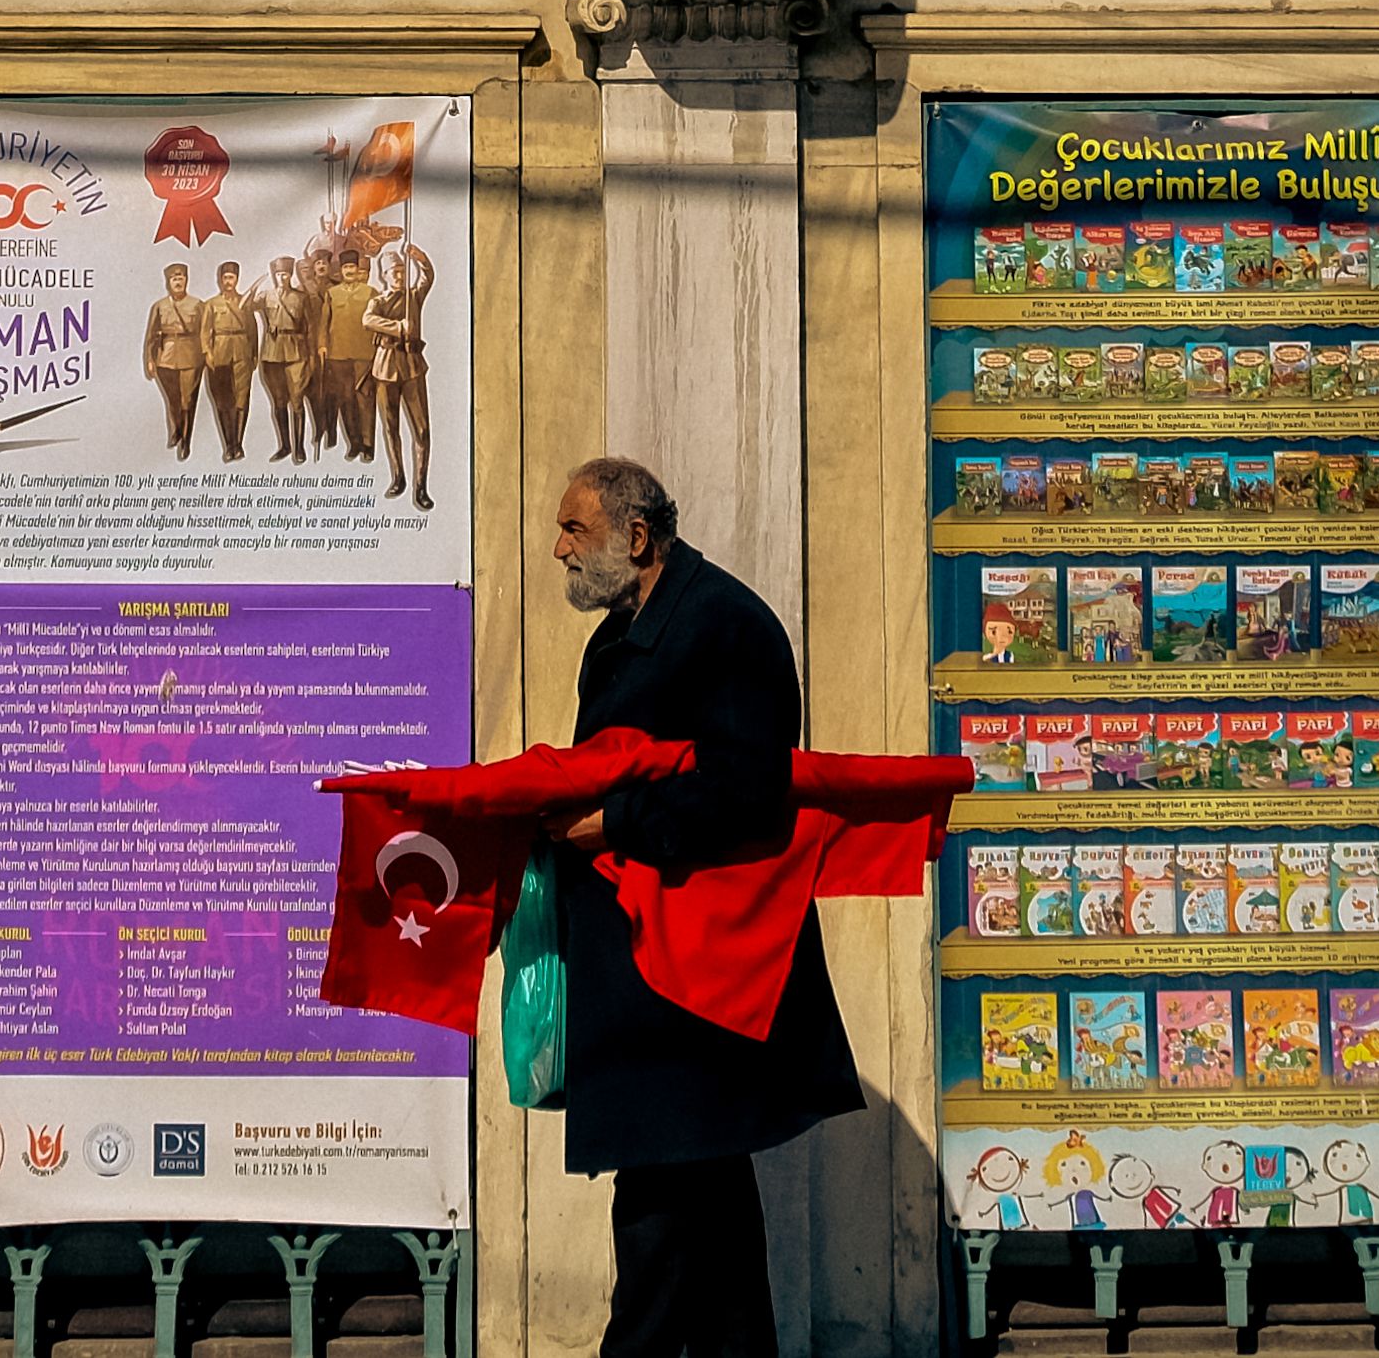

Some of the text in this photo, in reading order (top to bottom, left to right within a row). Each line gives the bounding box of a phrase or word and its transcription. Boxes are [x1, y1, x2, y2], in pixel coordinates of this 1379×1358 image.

[177, 139, 195, 150] SON
[1055, 131, 1289, 171] Çocuklarımız
[161, 161, 210, 177] 30 NİSAN
[172, 178, 200, 190] 2023
[989, 168, 1261, 211] Değerlerimizle
[20, 474, 110, 491] Cumhuriyetimizin
[137, 474, 155, 491] yılı
[156, 474, 199, 491] şerefine
[201, 473, 227, 488] Millî
[228, 473, 280, 488] Mücadele
[281, 473, 319, 488] ruhunu
[320, 473, 354, 488] daima
[356, 474, 374, 488] diri
[118, 602, 229, 620] YARIŞMA ŞARTLARI
[118, 925, 208, 944] ÖN SEÇİCİ KURUL
[234, 1119, 382, 1143] Başvuru ve Bilgi İçin:
[161, 1130, 200, 1155] D'S
